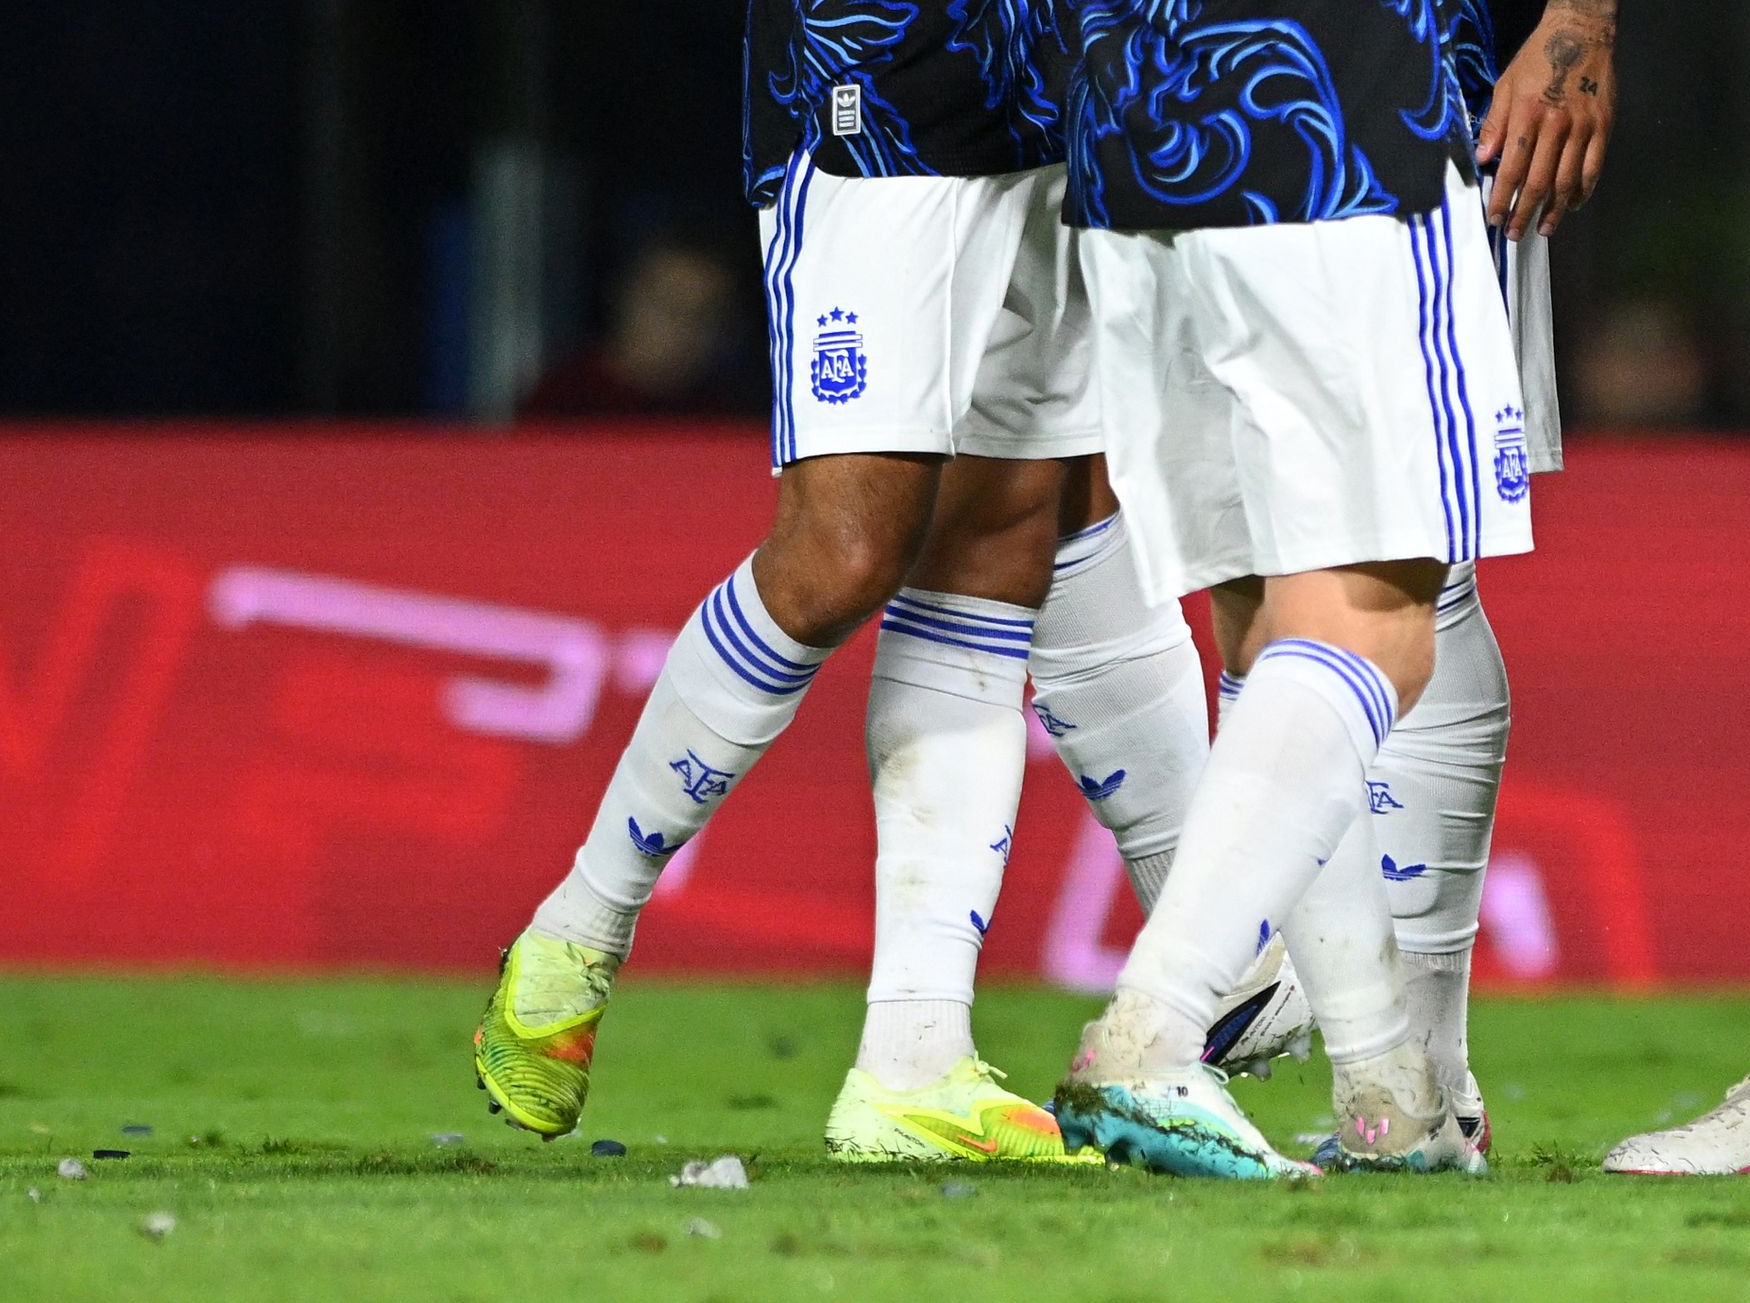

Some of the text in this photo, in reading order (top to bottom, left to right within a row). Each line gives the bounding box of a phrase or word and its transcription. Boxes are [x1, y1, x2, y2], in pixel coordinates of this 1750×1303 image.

[820, 348, 854, 384] AFA
[668, 748, 736, 804] AFA
[1364, 780, 1405, 815] FA
[1176, 1085, 1189, 1098] 10
